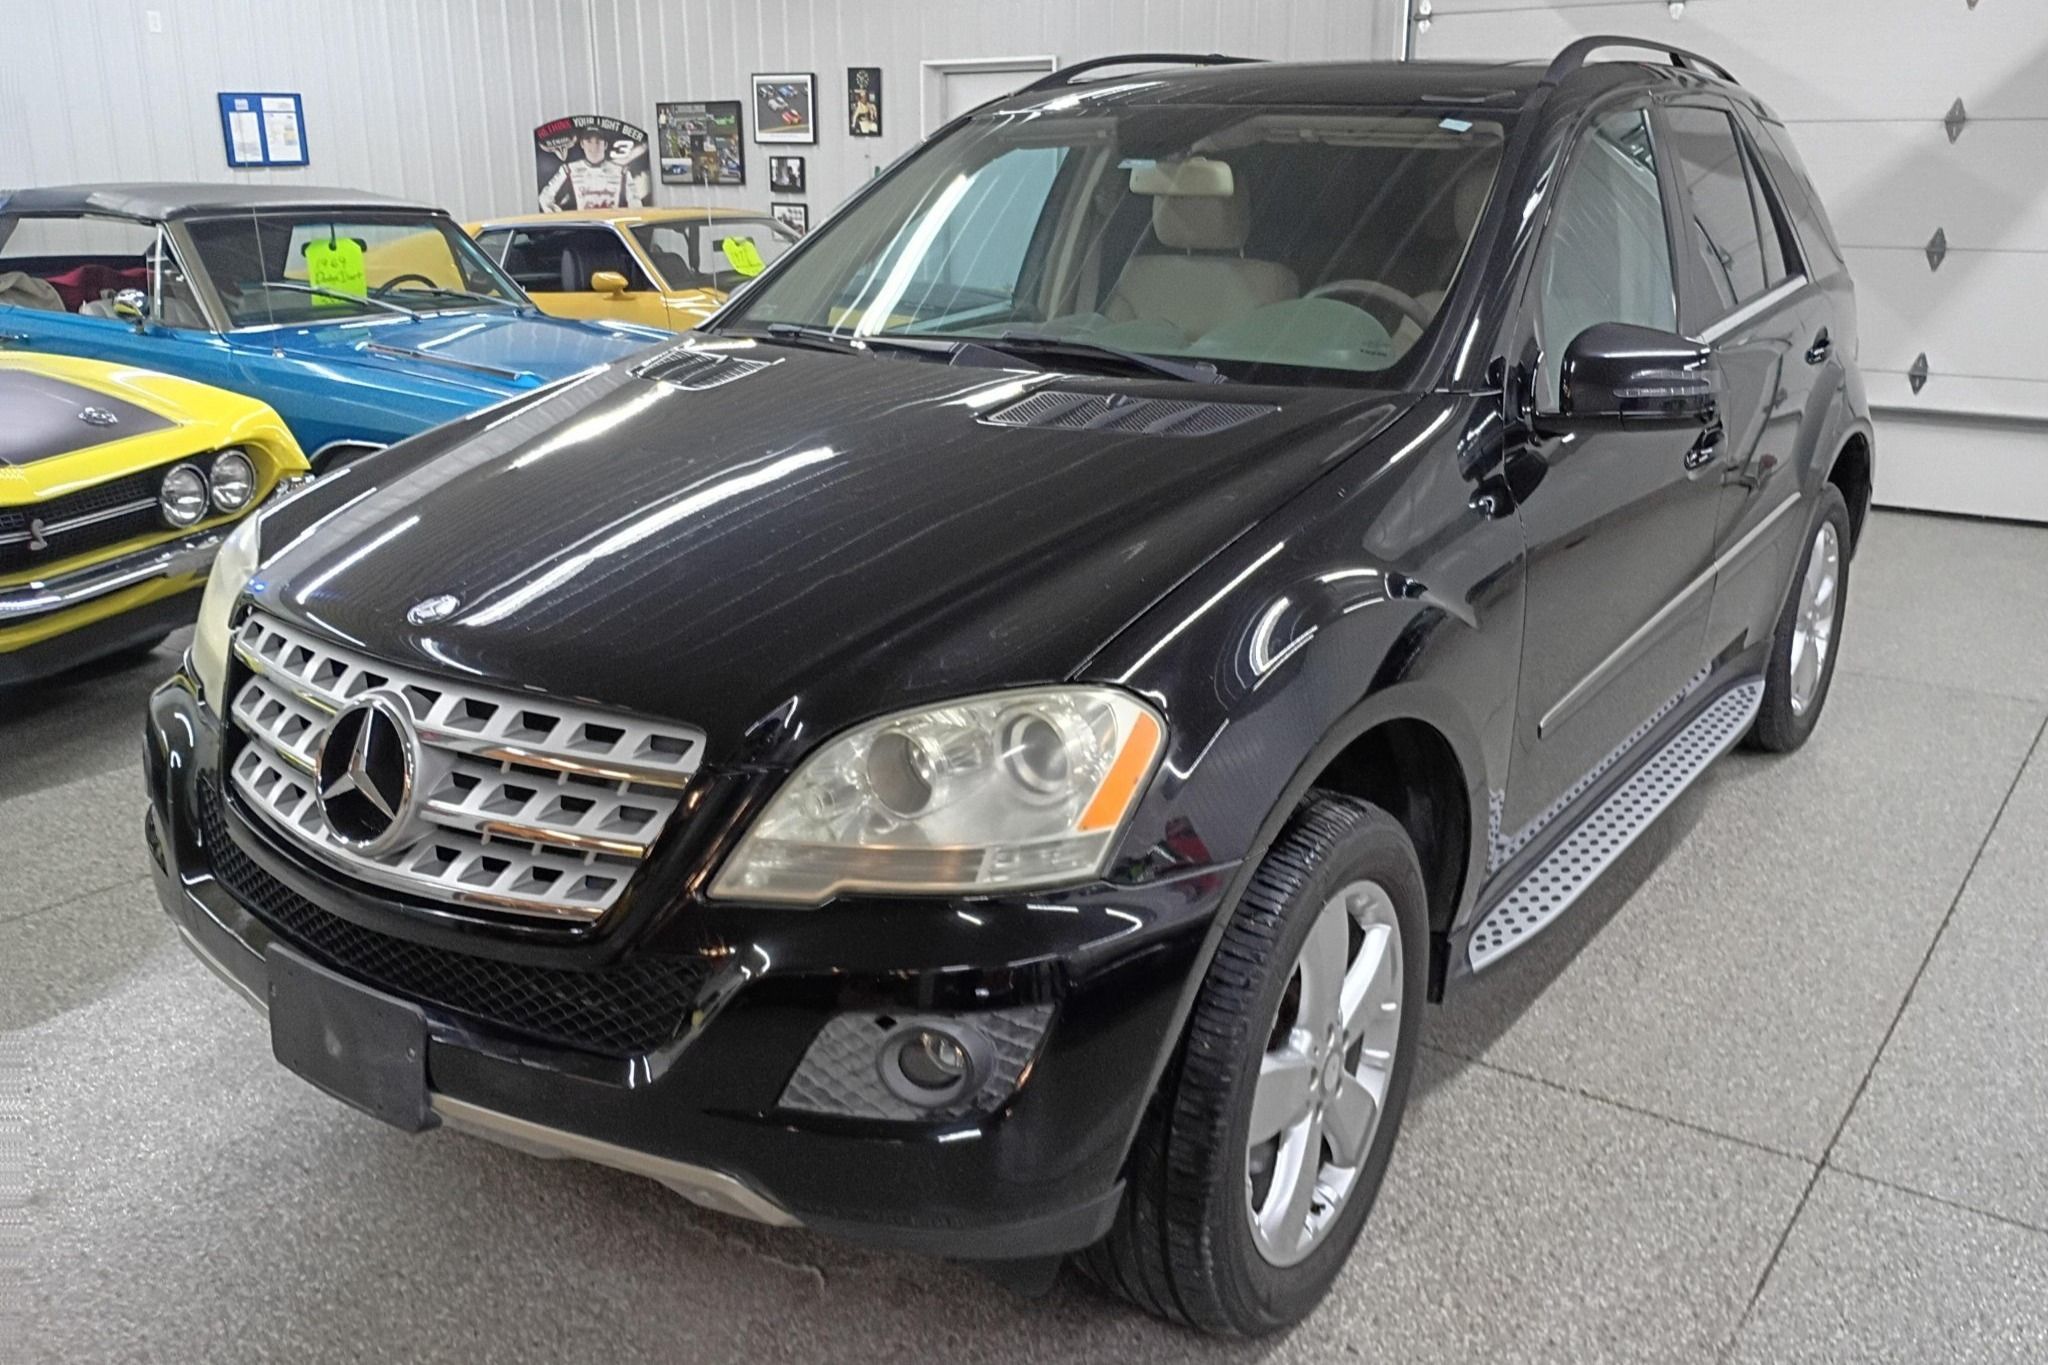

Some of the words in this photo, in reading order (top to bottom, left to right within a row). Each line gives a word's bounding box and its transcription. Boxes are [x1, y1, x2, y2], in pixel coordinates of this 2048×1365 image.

[573, 117, 594, 127] YOUR
[597, 118, 620, 132] LIGHT
[622, 125, 644, 141] BEER
[610, 140, 634, 159] 3
